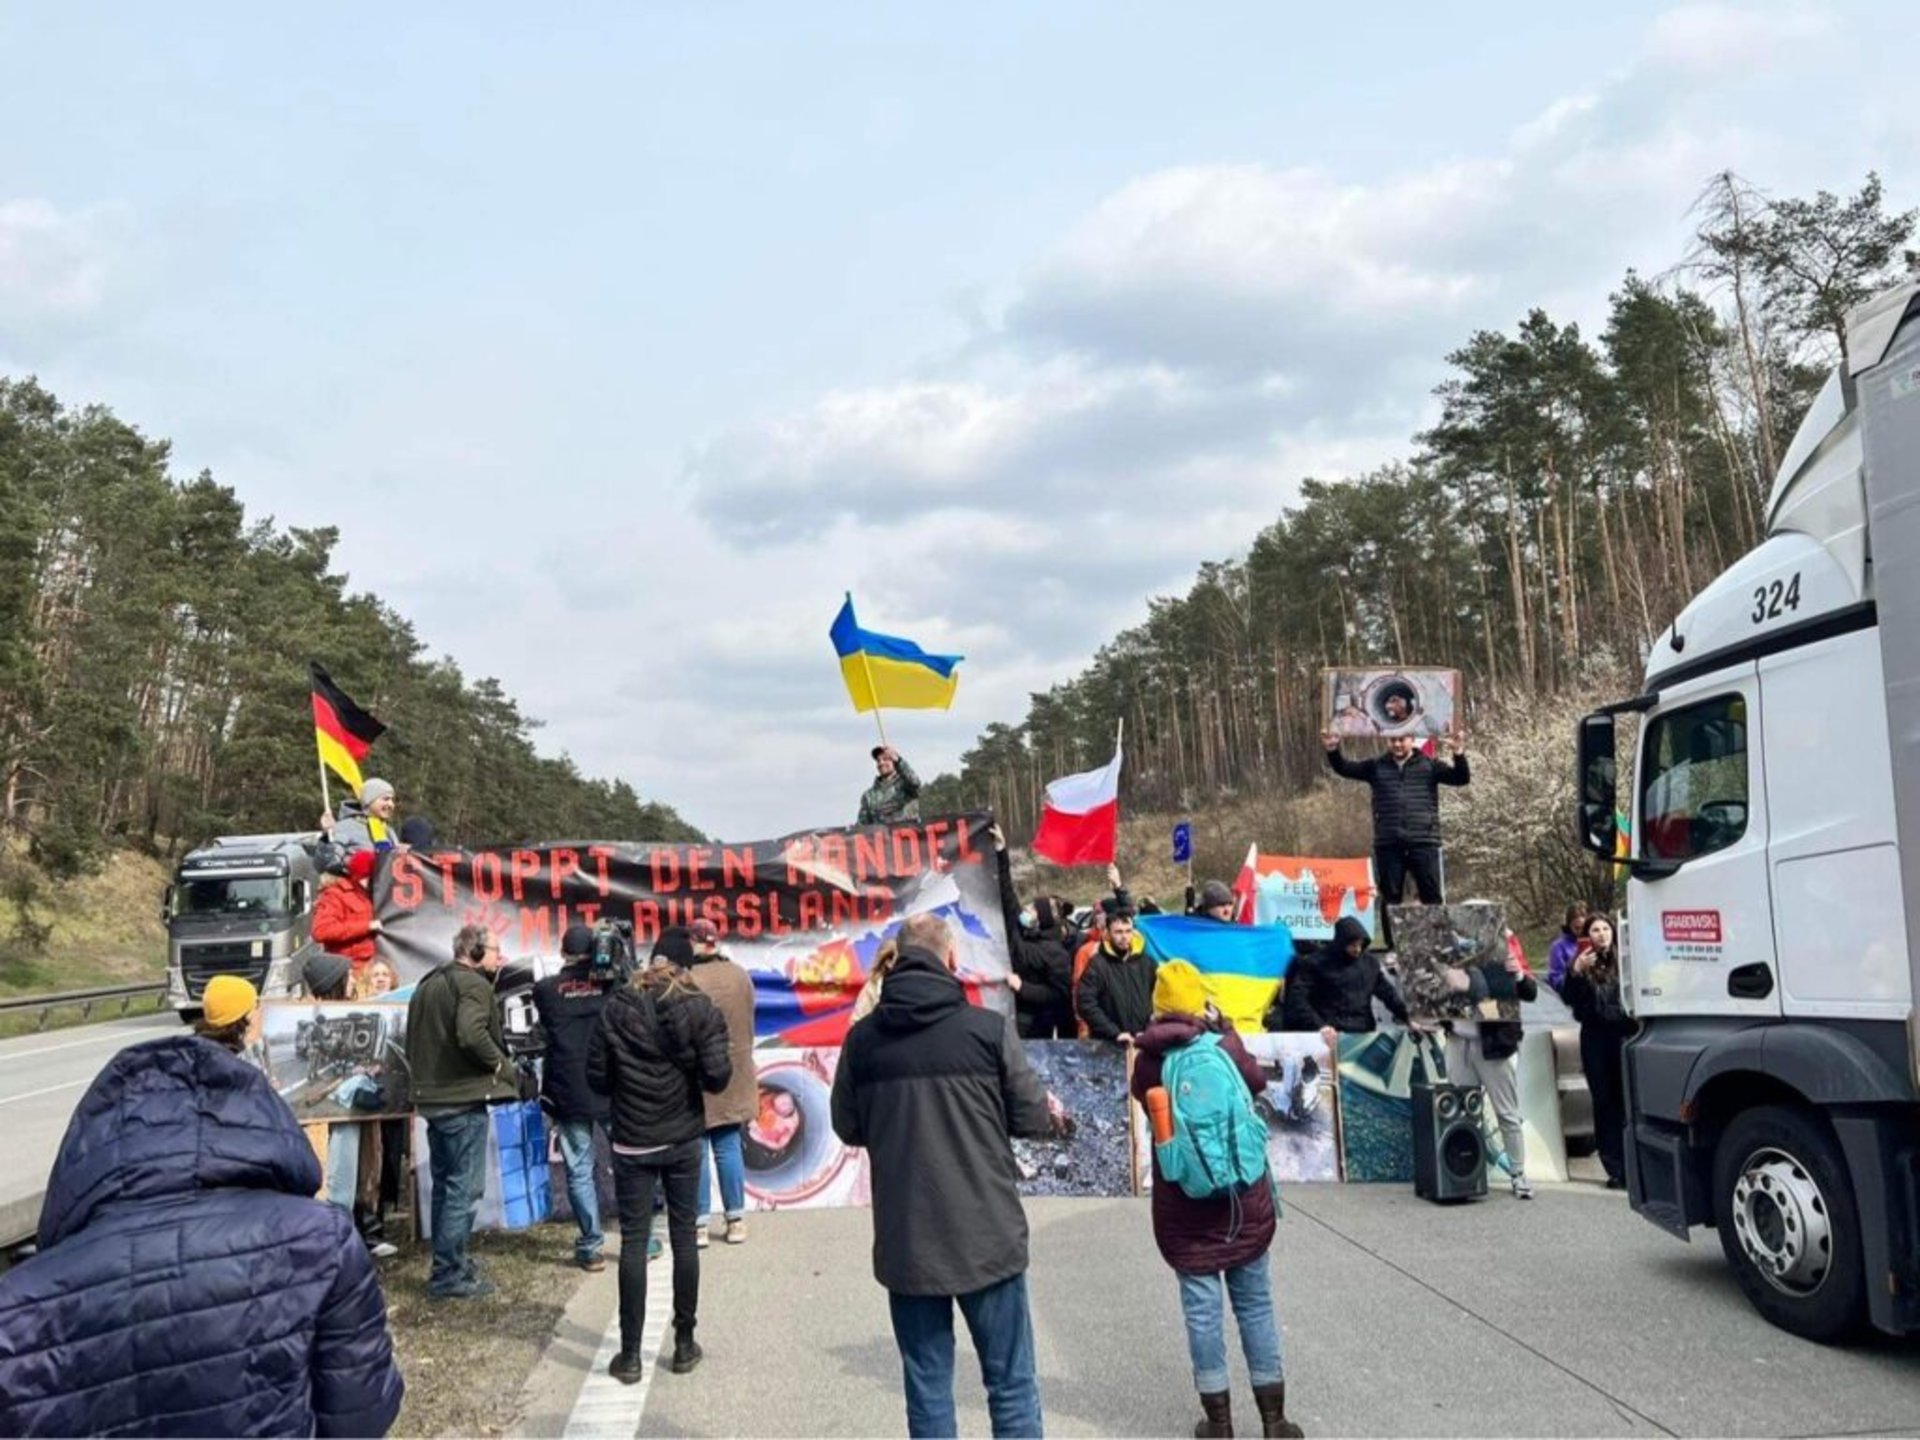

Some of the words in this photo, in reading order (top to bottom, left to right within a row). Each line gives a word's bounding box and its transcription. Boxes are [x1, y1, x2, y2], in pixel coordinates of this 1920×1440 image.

[1752, 571, 1801, 624] 324
[391, 845, 615, 909] STOPPT
[652, 846, 755, 894] DEN
[786, 818, 982, 886] HANDEL
[518, 902, 601, 952] MIT
[632, 886, 896, 945] RUSSLAND
[1302, 899, 1329, 911] THE
